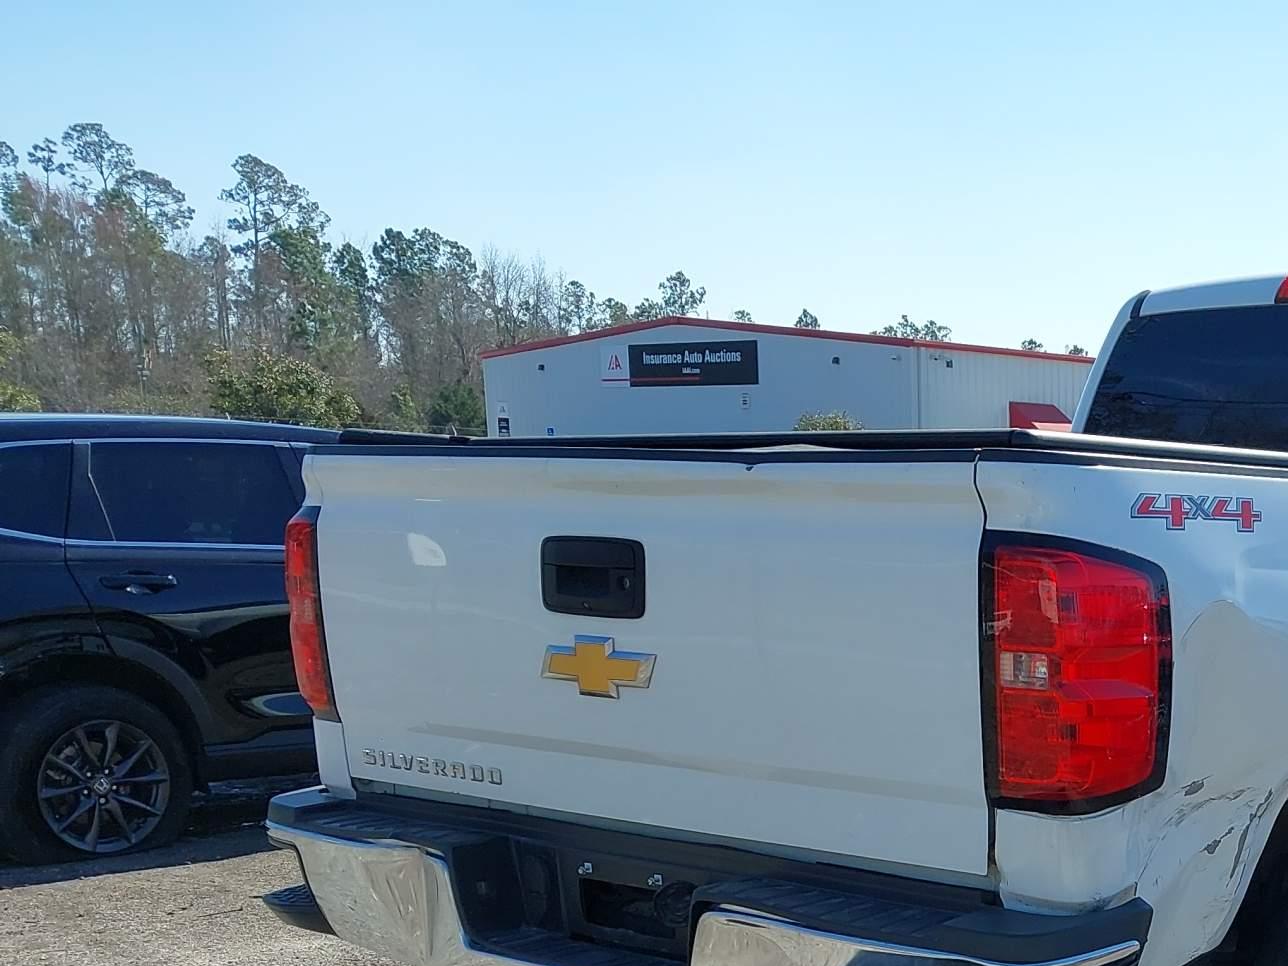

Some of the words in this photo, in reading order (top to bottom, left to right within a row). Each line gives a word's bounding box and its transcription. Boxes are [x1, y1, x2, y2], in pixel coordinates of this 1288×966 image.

[643, 351, 682, 365] Insurance
[684, 350, 702, 363] Auto
[704, 349, 741, 363] Auctions
[362, 748, 503, 785] SILVERADO
